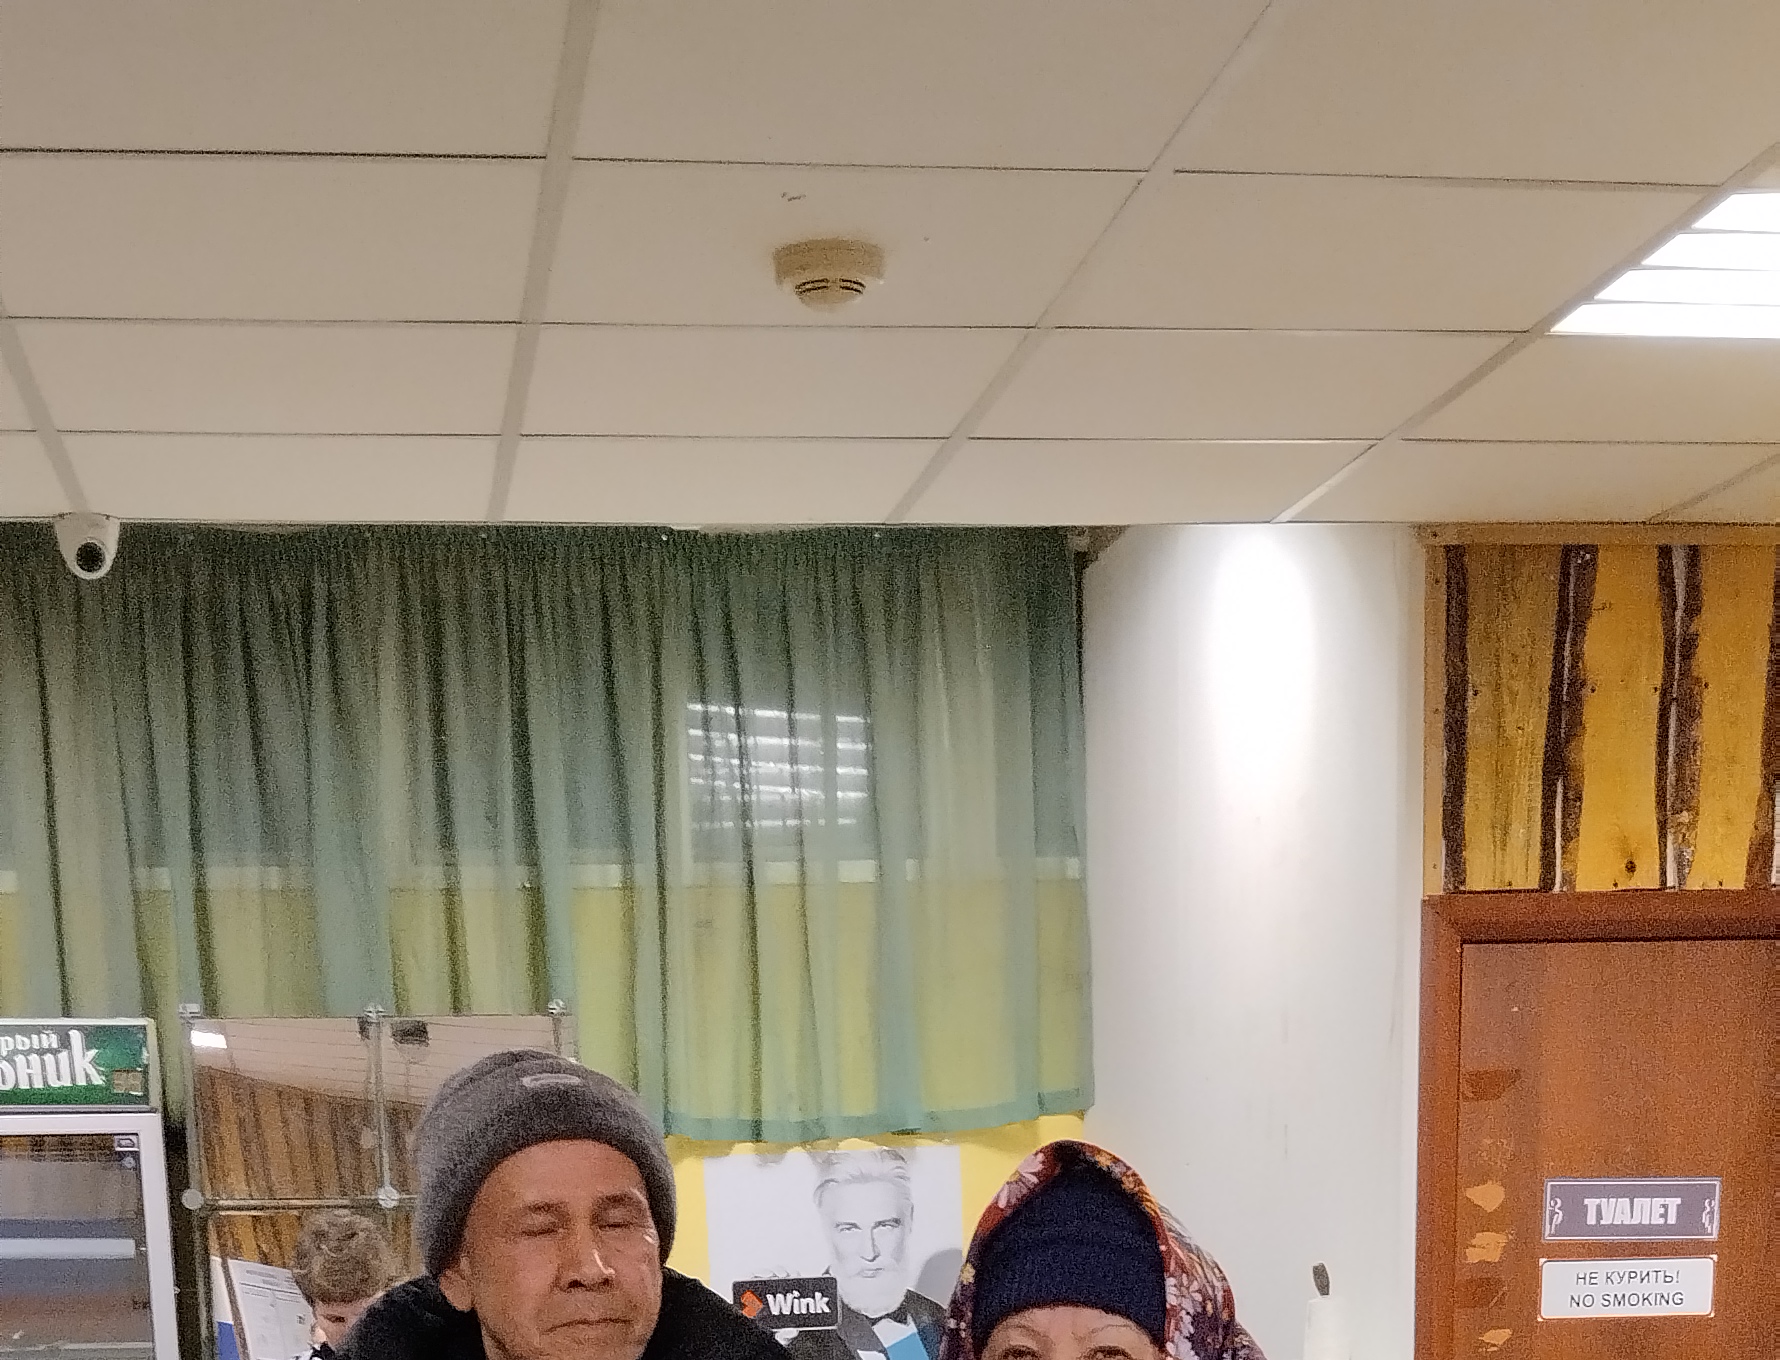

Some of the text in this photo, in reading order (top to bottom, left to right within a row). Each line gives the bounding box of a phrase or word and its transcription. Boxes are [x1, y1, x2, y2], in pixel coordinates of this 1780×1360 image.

[1584, 1197, 1681, 1225] ТУАЛЕТ
[1576, 1270, 1680, 1286] НЕ КУРИТЬ!
[766, 1290, 831, 1315] Wink
[1569, 1292, 1684, 1308] NO SMOKING
